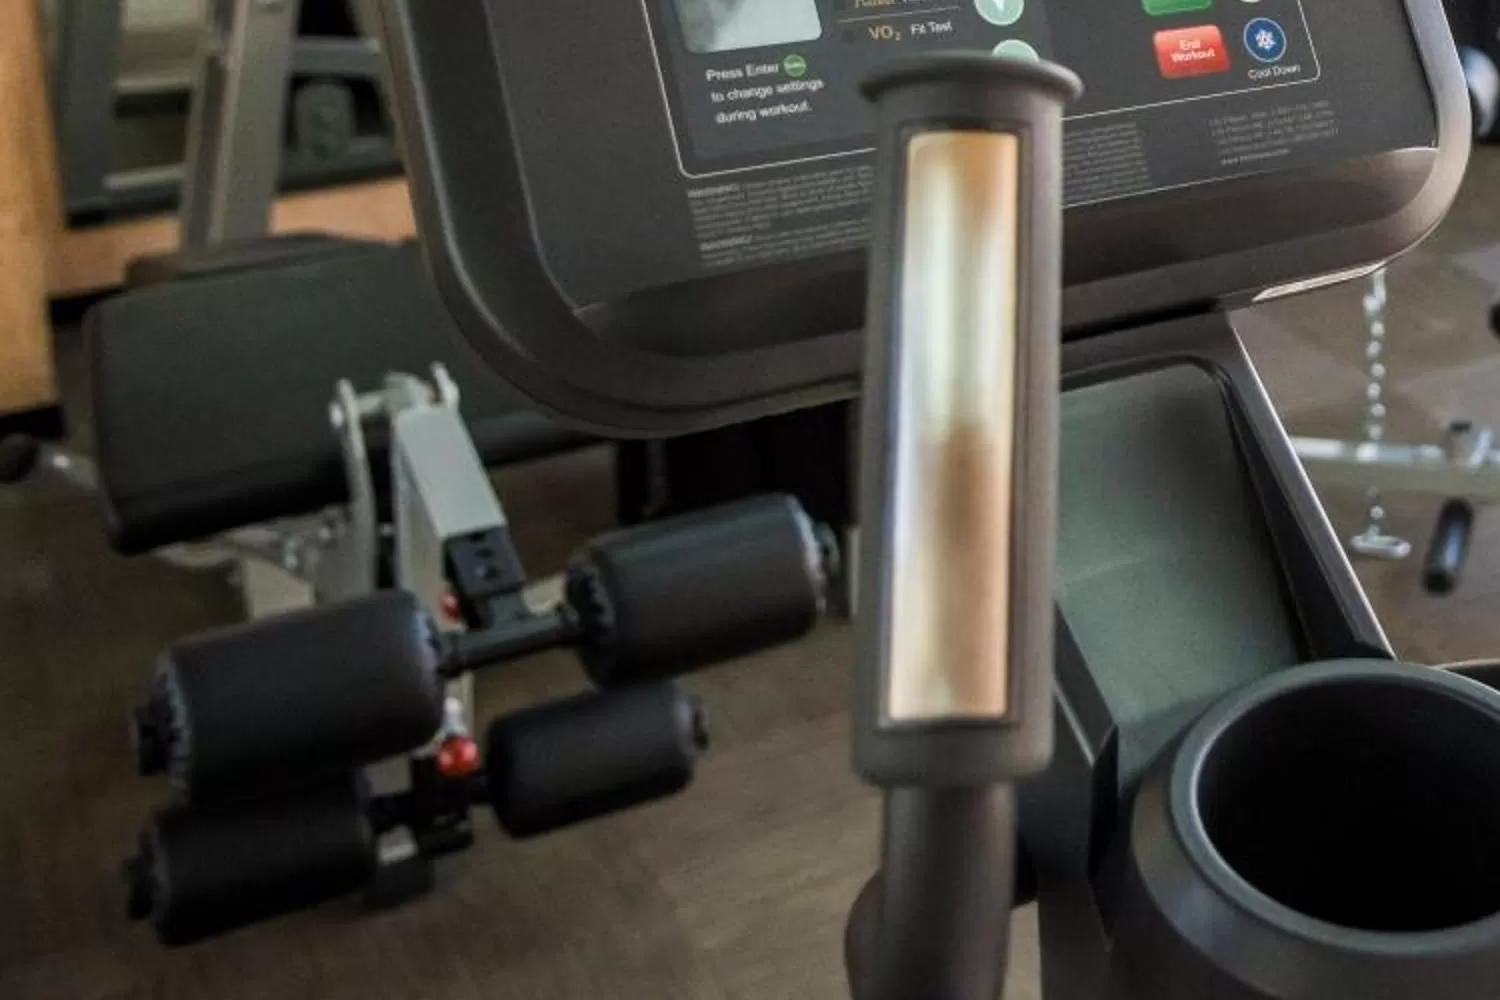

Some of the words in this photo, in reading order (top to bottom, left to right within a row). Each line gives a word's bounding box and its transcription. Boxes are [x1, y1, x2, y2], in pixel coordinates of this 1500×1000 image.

[910, 20, 930, 36] Fit
[1170, 48, 1216, 64] Workout
[705, 68, 744, 81] Press
[745, 63, 779, 77] Enter
[1247, 66, 1272, 80] Cool
[1272, 63, 1301, 77] Down
[710, 92, 725, 103] to
[726, 85, 774, 100] change
[775, 78, 826, 94] settings
[715, 107, 757, 125] during
